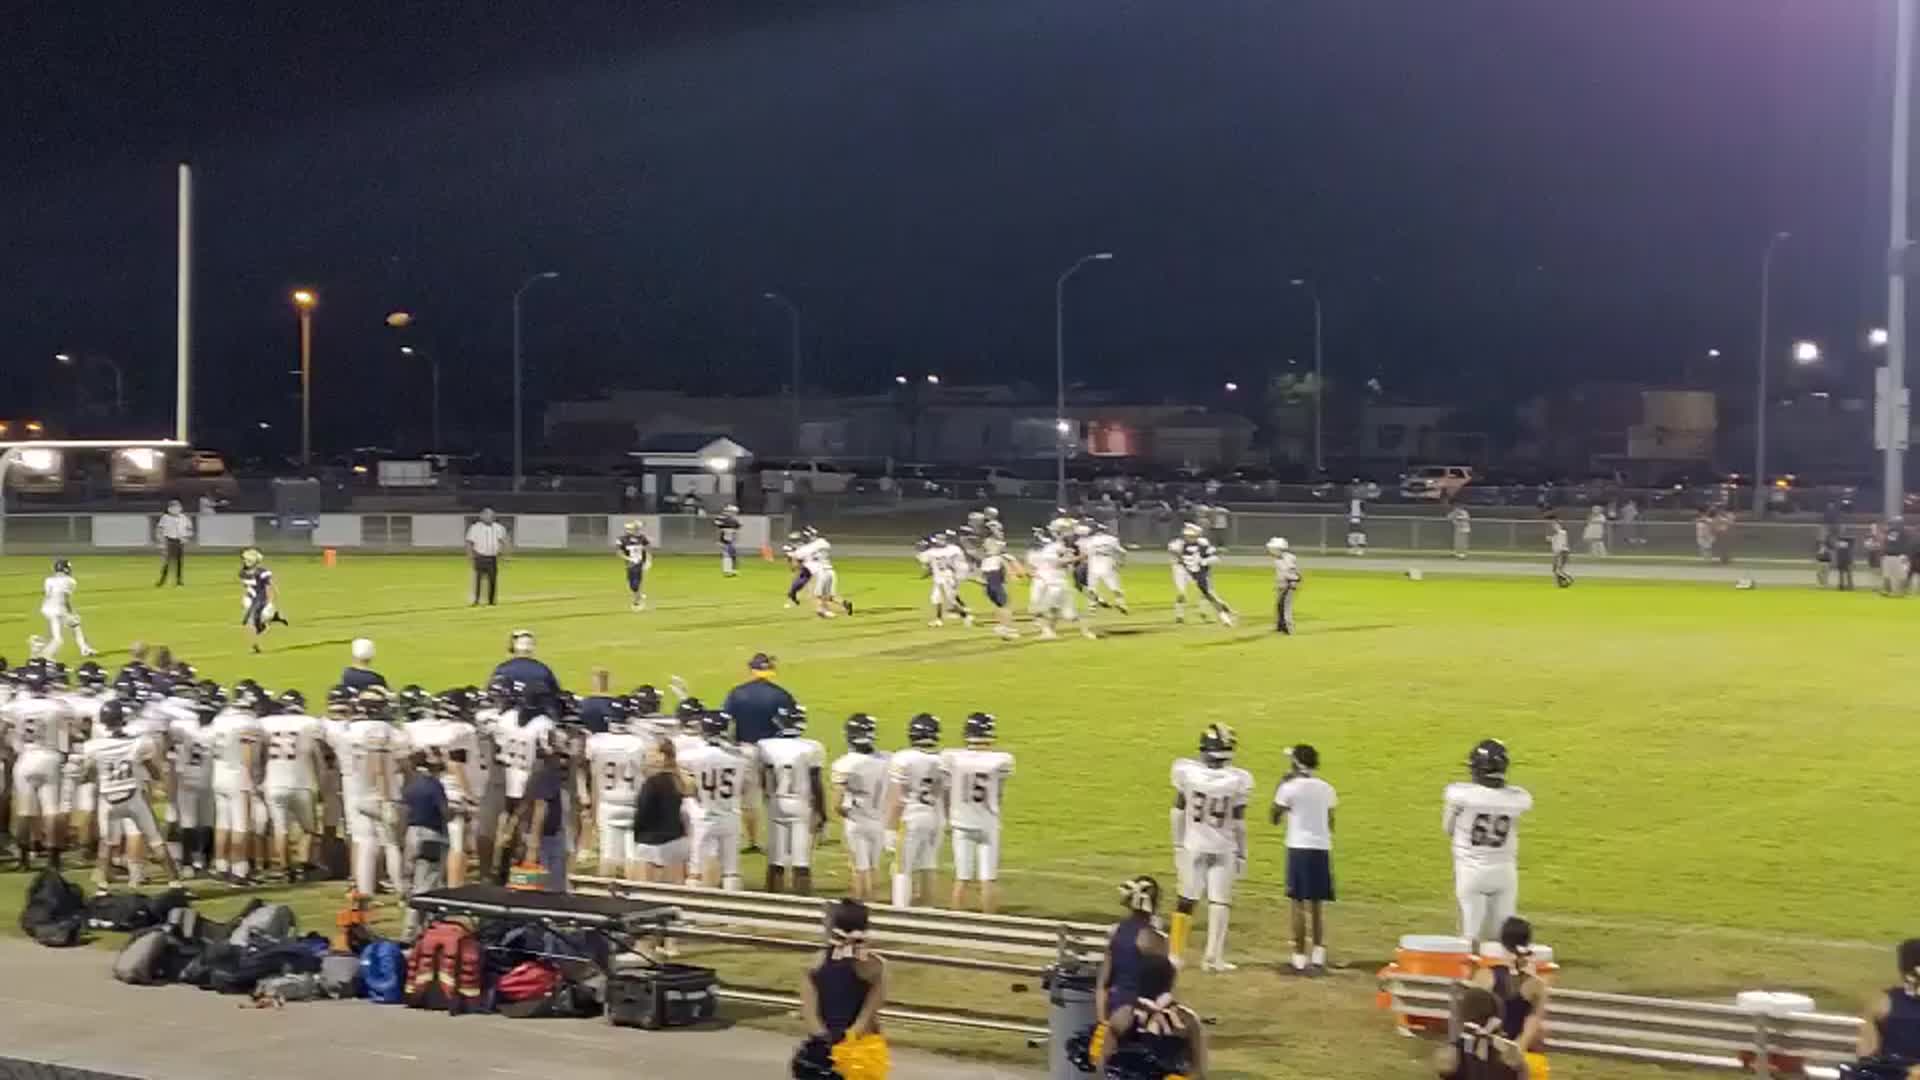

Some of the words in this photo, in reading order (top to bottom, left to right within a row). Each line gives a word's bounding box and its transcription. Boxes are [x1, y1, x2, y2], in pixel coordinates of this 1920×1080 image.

[702, 767, 735, 799] 45
[962, 772, 989, 803] 15
[1193, 790, 1230, 828] 34
[1472, 814, 1510, 848] 69
